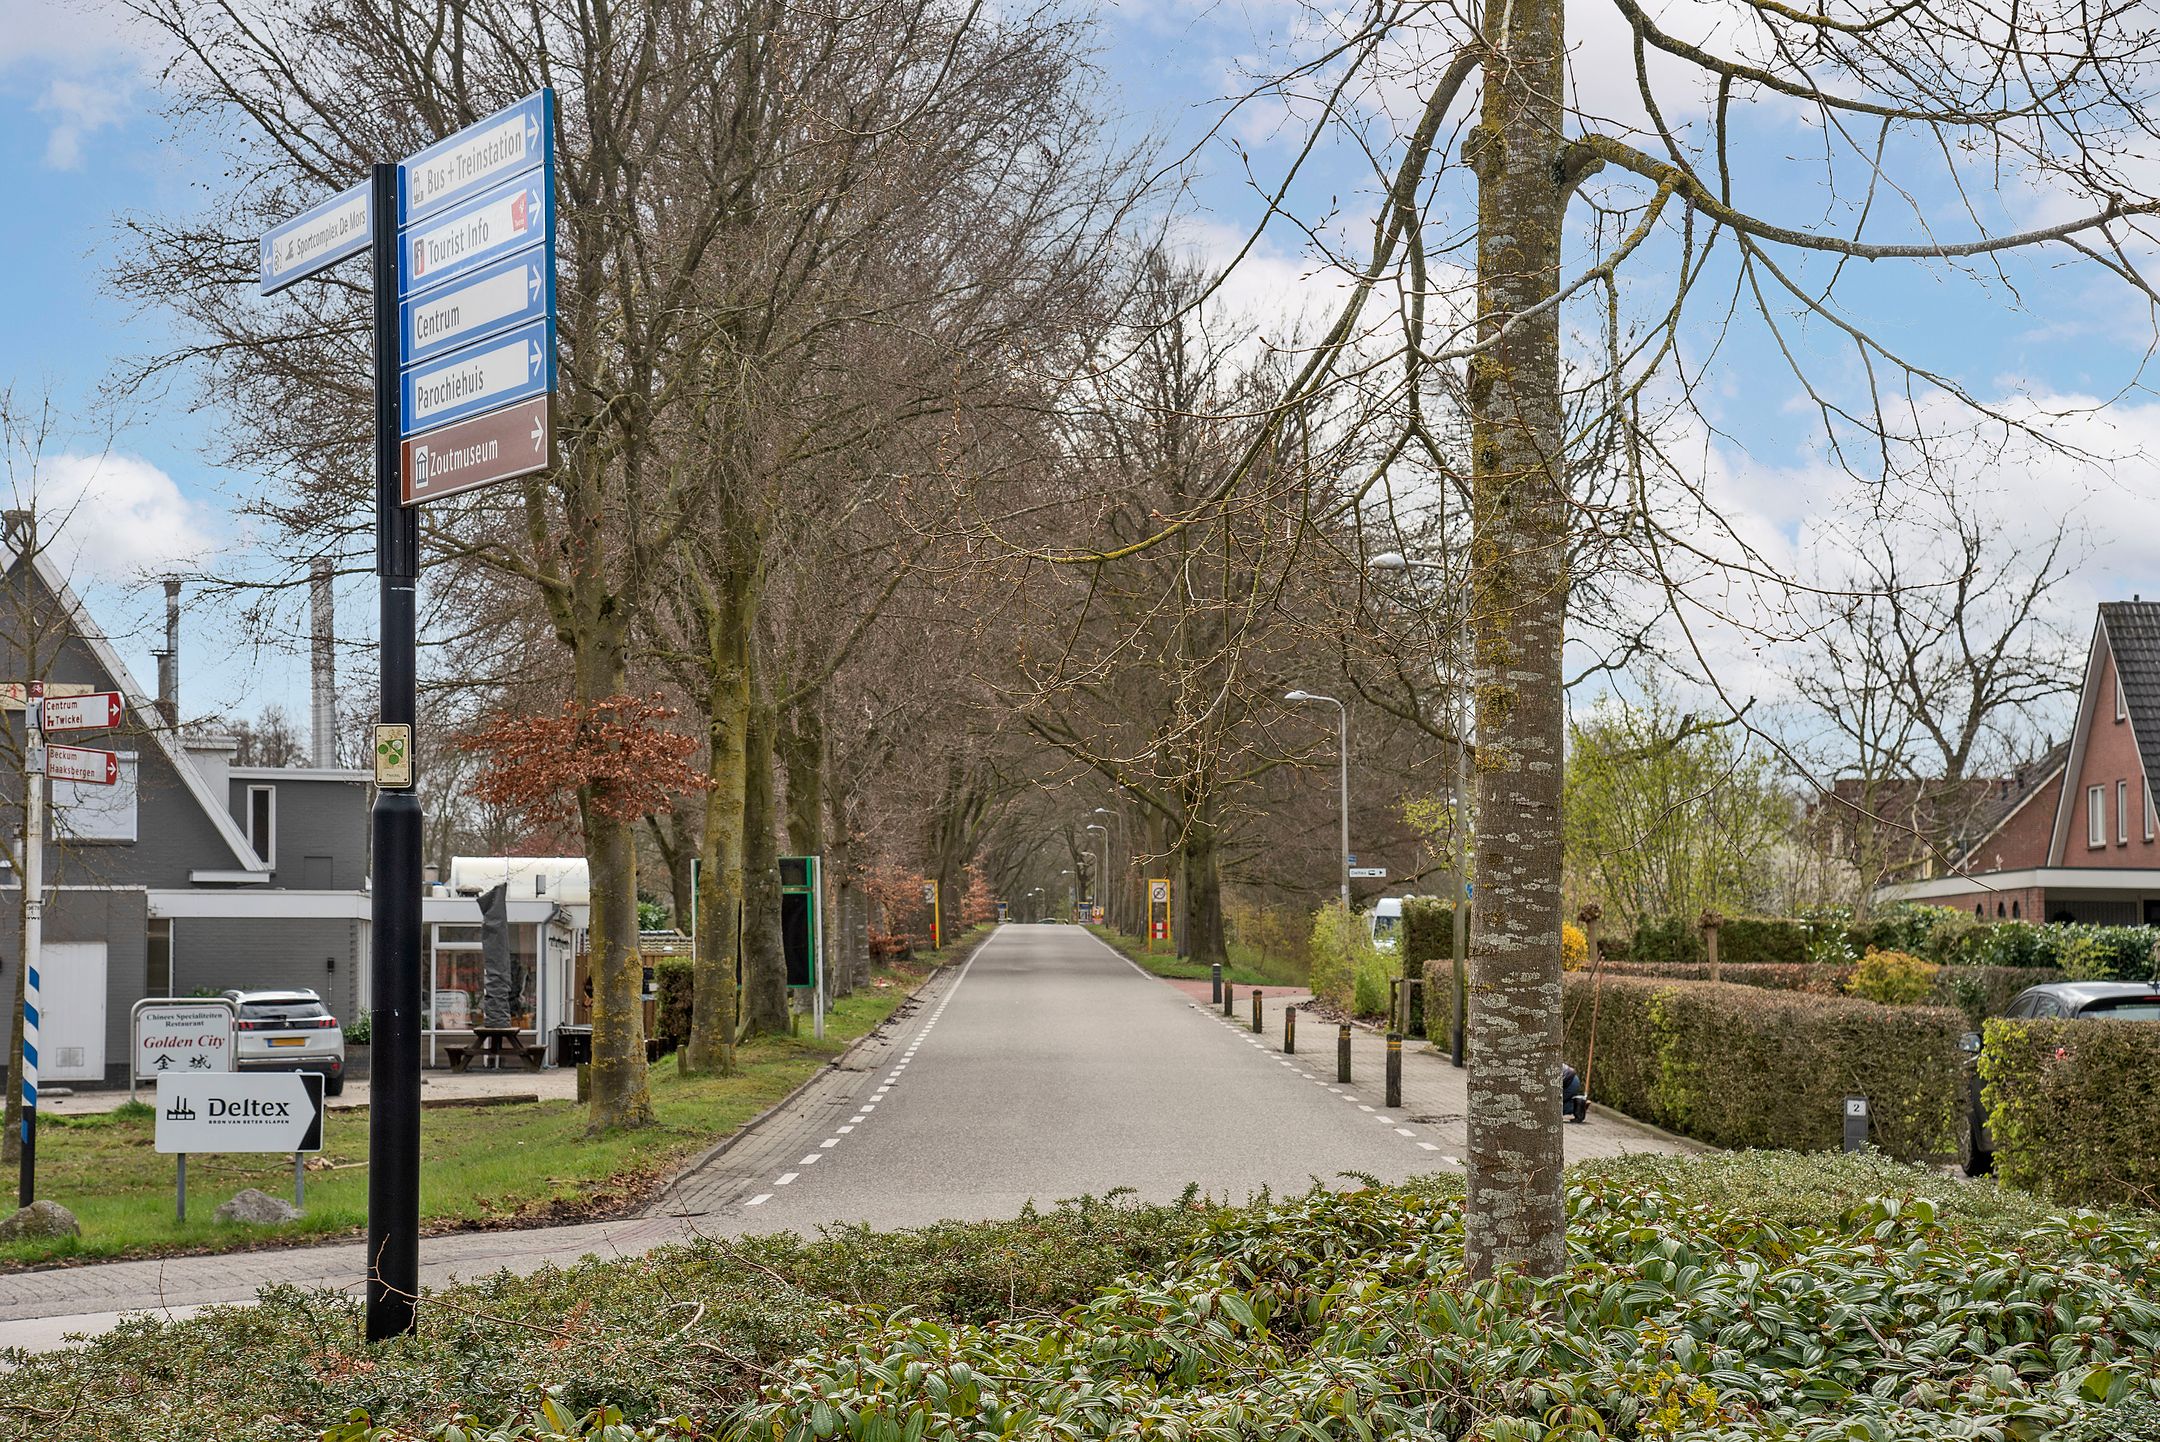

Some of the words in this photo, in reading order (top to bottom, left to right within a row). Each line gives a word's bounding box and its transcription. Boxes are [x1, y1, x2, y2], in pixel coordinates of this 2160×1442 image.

[427, 167, 445, 194] Bus
[456, 131, 522, 181] Treinstation
[296, 223, 339, 259] Sportcomplex
[339, 217, 349, 236] De
[349, 210, 366, 230] Mors
[428, 227, 465, 265] Tourist
[467, 217, 489, 250] Info
[416, 304, 460, 340] Centrum
[417, 366, 484, 411] Parochiehuis
[430, 438, 498, 476] Zoutmuseum
[46, 700, 78, 711] Centrum
[56, 714, 83, 725] Twickel
[50, 749, 77, 761] Beckum
[49, 764, 95, 778] Haaksbergen
[175, 1012, 223, 1021] Specialiteiten
[144, 1035, 193, 1049] Golden
[198, 1034, 225, 1050] City
[208, 1098, 290, 1117] Deltex
[1854, 1104, 1860, 1112] 2
